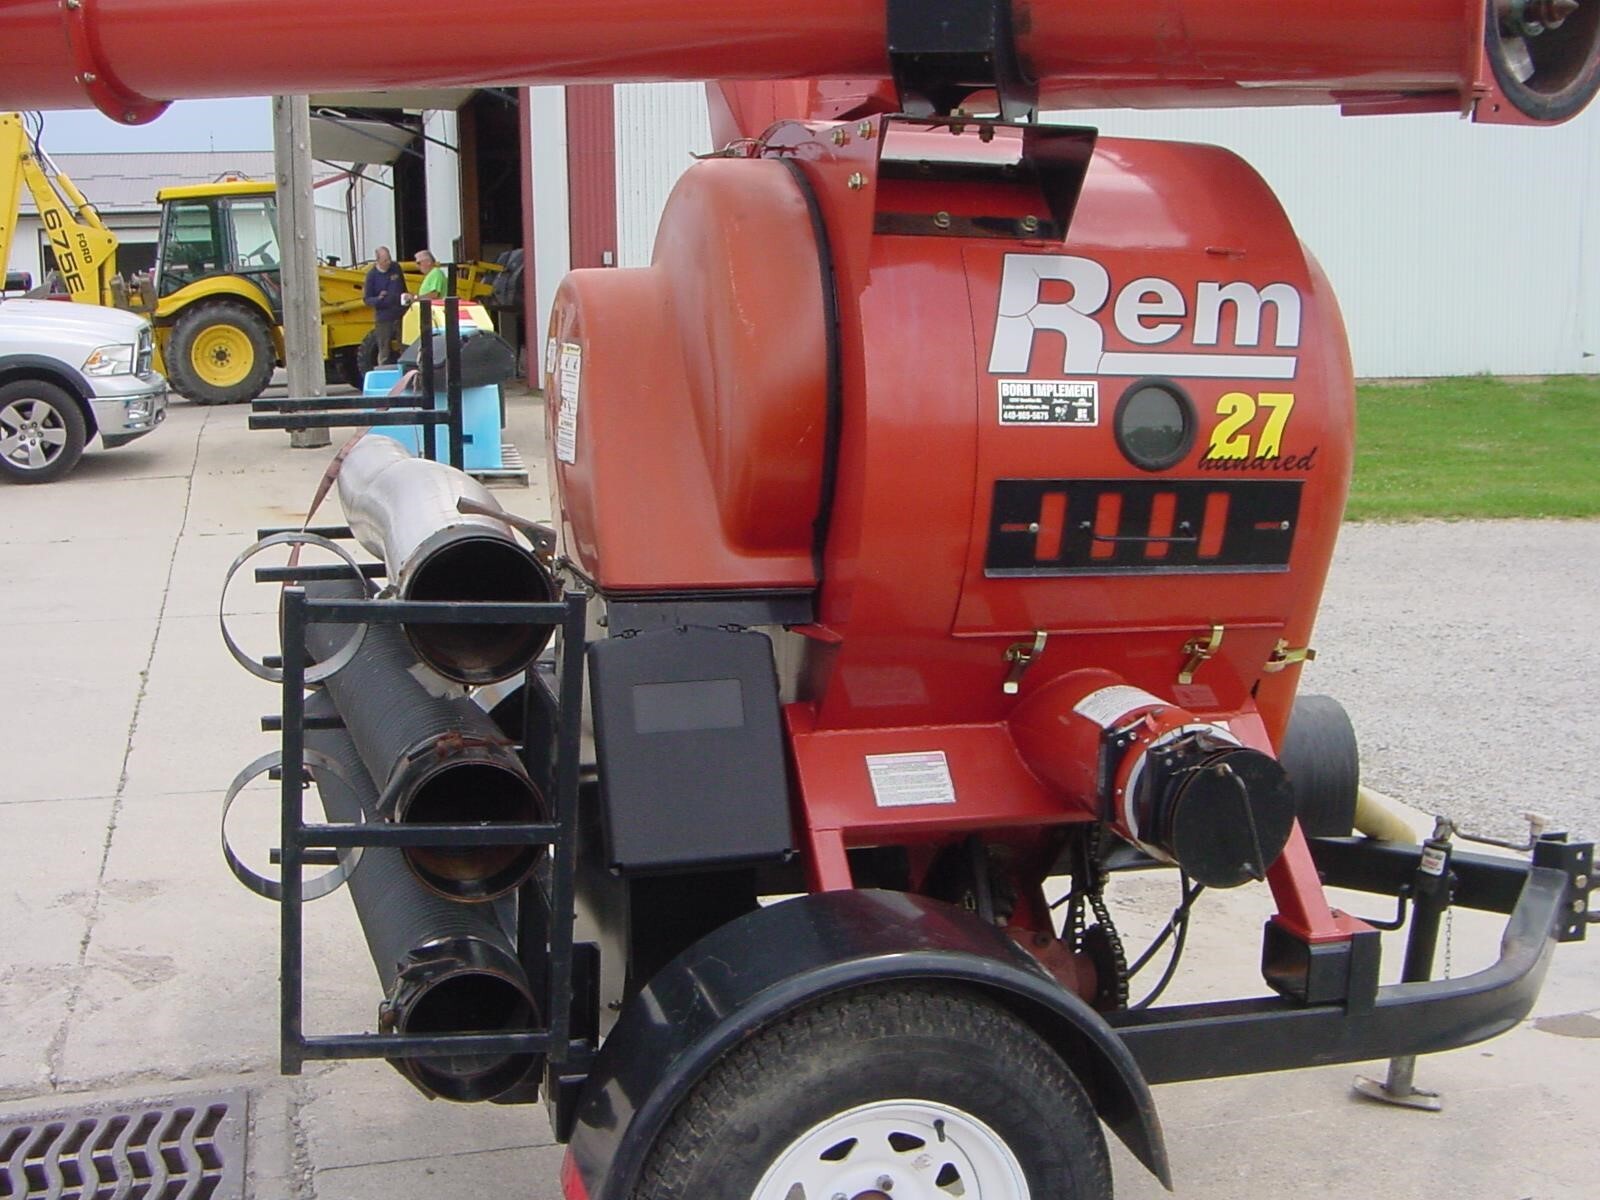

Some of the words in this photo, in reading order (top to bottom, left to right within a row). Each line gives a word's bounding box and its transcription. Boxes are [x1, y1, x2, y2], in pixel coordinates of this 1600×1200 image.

[43, 208, 86, 295] 675E
[76, 232, 93, 264] FORD
[987, 252, 1303, 376] Rem
[1001, 383, 1032, 397] BORN
[1032, 384, 1094, 398] IMPLEMENT
[1205, 391, 1295, 460] 27
[1198, 446, 1317, 472] hundred
